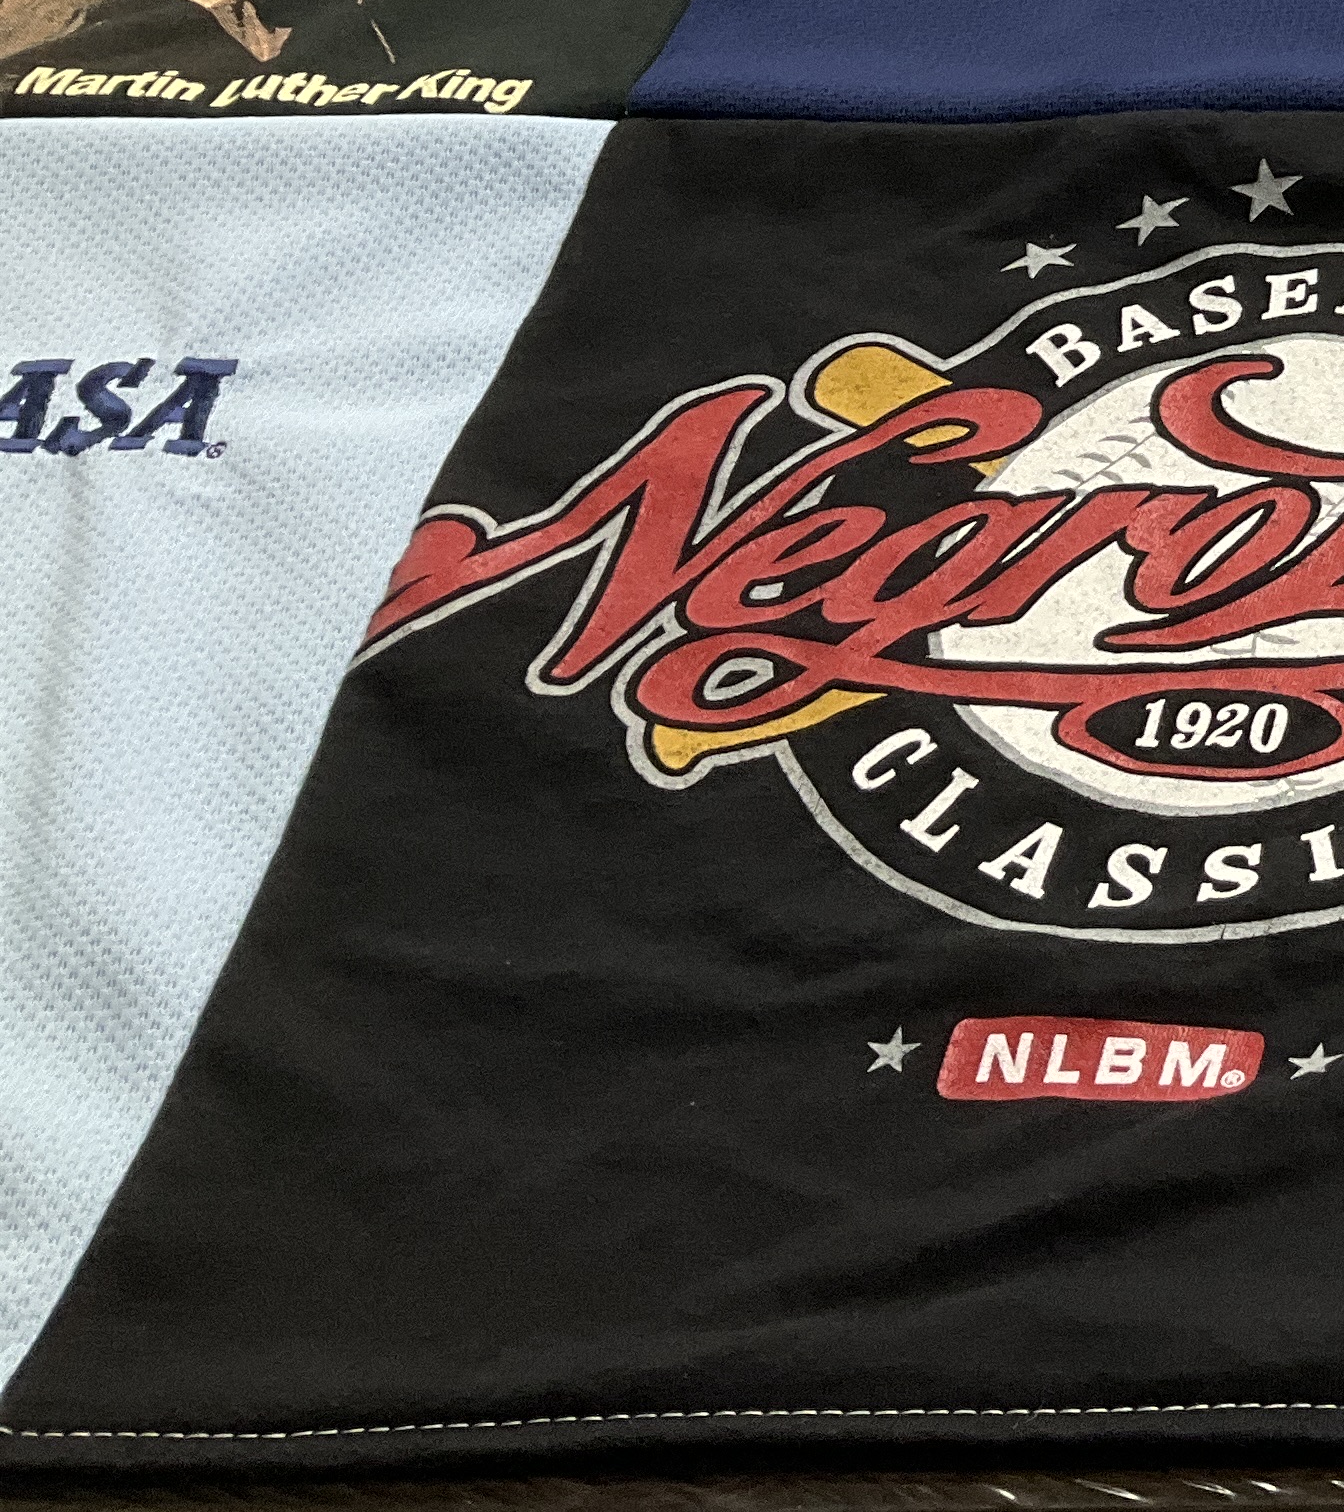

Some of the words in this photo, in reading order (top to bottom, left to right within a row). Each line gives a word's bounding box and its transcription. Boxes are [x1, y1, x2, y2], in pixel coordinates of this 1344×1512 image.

[15, 67, 206, 102] Martin
[209, 72, 399, 108] Luther
[397, 69, 533, 115] King
[363, 385, 1322, 728] Negro
[1136, 698, 1290, 756] 1920
